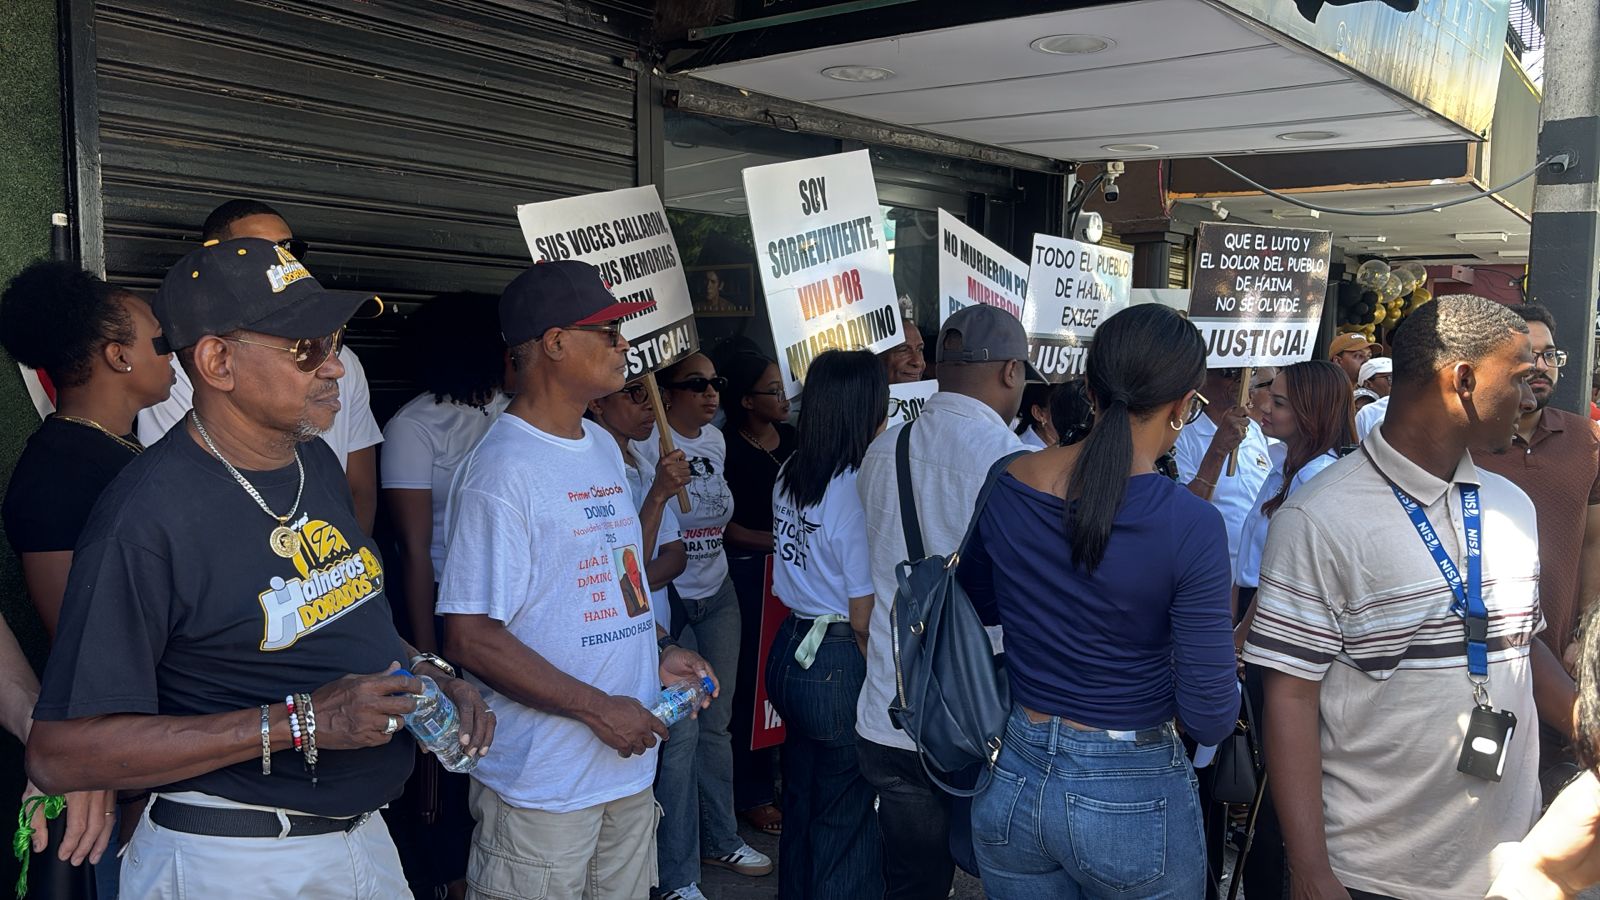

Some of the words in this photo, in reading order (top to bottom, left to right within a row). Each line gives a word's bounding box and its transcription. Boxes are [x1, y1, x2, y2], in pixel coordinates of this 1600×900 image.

[799, 177, 828, 216] SOY
[536, 234, 570, 262] SUS
[566, 222, 615, 256] VOCES
[613, 211, 668, 245] CALLARON,
[768, 216, 880, 278] SOBREVIVIENTE,
[1224, 234, 1251, 251] QUE
[1254, 234, 1268, 250] EL
[1272, 236, 1300, 252] LUTO
[1304, 238, 1310, 252] Y
[620, 244, 676, 282] MEMORIAS
[944, 228, 958, 258] NO
[960, 240, 1012, 292] MURIERON
[1036, 246, 1075, 269] TODO
[1080, 252, 1093, 272] EL
[1096, 255, 1130, 278] PUEBLO
[1200, 253, 1215, 268] EL
[1220, 254, 1260, 270] DOLOR
[1264, 256, 1284, 272] DEL
[1288, 258, 1324, 272] PUEBLO
[798, 279, 834, 321] VIVA
[833, 268, 864, 310] POR
[1056, 278, 1074, 298] DE
[1076, 280, 1112, 302] HAINA
[1236, 276, 1252, 292] DE
[1254, 277, 1292, 292] HAINA
[1216, 297, 1236, 312] NO
[1239, 298, 1254, 312] SE
[1258, 298, 1302, 312] OLVIDE.
[848, 304, 896, 348] DIVINO
[1062, 306, 1099, 328] EXIGE
[568, 491, 590, 502] Primer
[614, 482, 623, 494] de
[1464, 492, 1477, 512] NIS
[1418, 522, 1435, 542] NIS
[1468, 528, 1478, 548] NIS
[1440, 559, 1456, 580] NIS
[298, 574, 372, 628] DORADOS
[592, 592, 606, 603] DE
[584, 608, 618, 622] HAINA
[582, 626, 636, 647] FERNANDO
